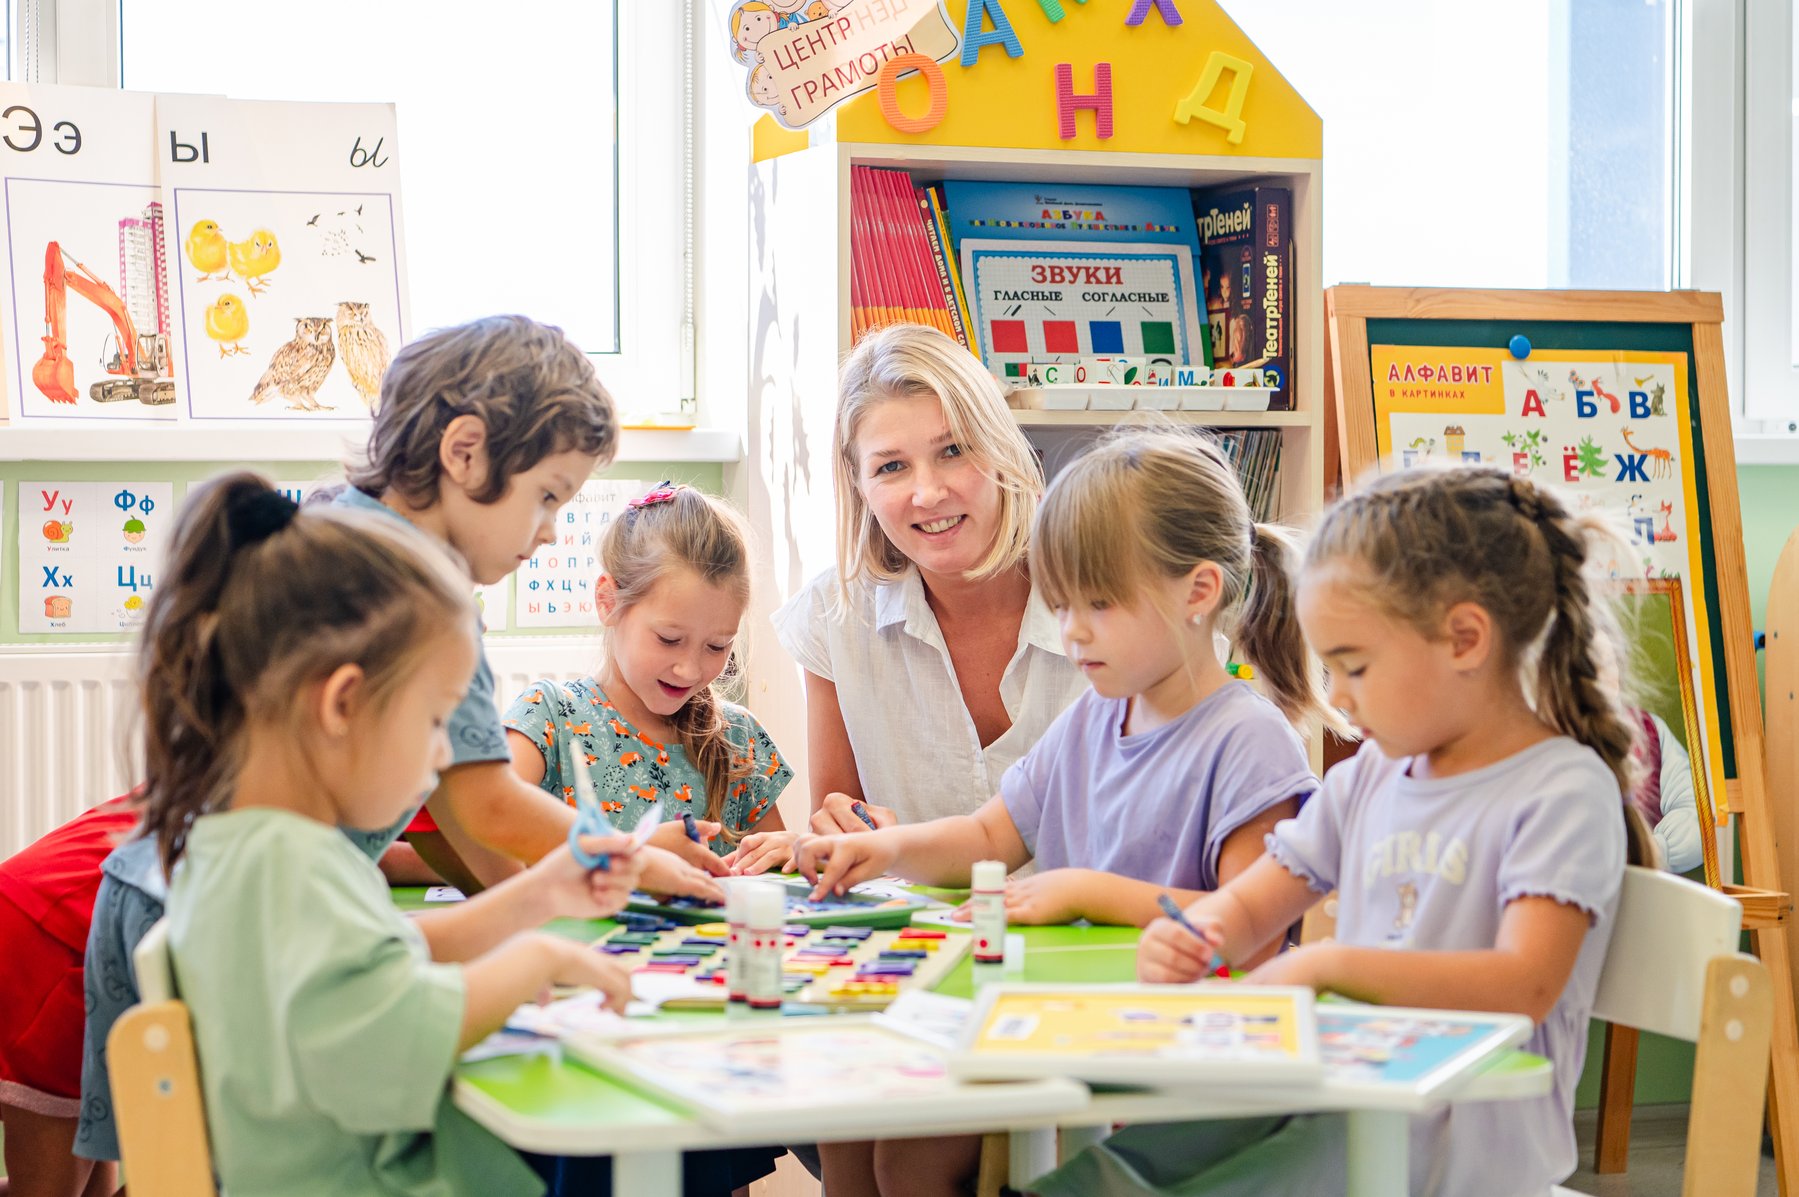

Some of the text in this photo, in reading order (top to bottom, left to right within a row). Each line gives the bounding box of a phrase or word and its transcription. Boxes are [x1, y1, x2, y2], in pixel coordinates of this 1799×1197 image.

[773, 17, 851, 71] ЦЕНТР
[960, 0, 1024, 67] А
[791, 33, 916, 110] ГРАМОТЫ
[878, 53, 947, 133] О
[1054, 62, 1113, 140] Н
[1173, 51, 1254, 145] Д
[1041, 208, 1106, 221] АЗБУКА
[1031, 265, 1123, 285] ЗВУКИ
[934, 254, 947, 279] ДОМА
[946, 294, 962, 331] ДЕТСКОМ
[994, 290, 1169, 303] ГЛАСНЫЕ СОГЛАСНЫЕ
[1263, 254, 1281, 360] ТеатрТеней
[1045, 367, 1058, 384] С
[1076, 367, 1086, 384] О
[1178, 370, 1194, 386] М
[1388, 363, 1493, 384] АЛФАВИТ
[1402, 389, 1465, 399] КАРТИНКАХ
[1521, 389, 1651, 419] А Б В
[1562, 446, 1581, 482] Ё
[1614, 453, 1651, 482] Ж
[567, 512, 575, 523] В
[565, 535, 574, 545] И
[582, 531, 592, 545] Й
[529, 558, 538, 568] Н
[548, 558, 558, 568] О
[568, 557, 577, 568] П
[528, 580, 540, 591] Ф
[546, 580, 555, 591] Х
[562, 580, 572, 592] Ц
[529, 602, 592, 613] Ы Ь Э Ю
